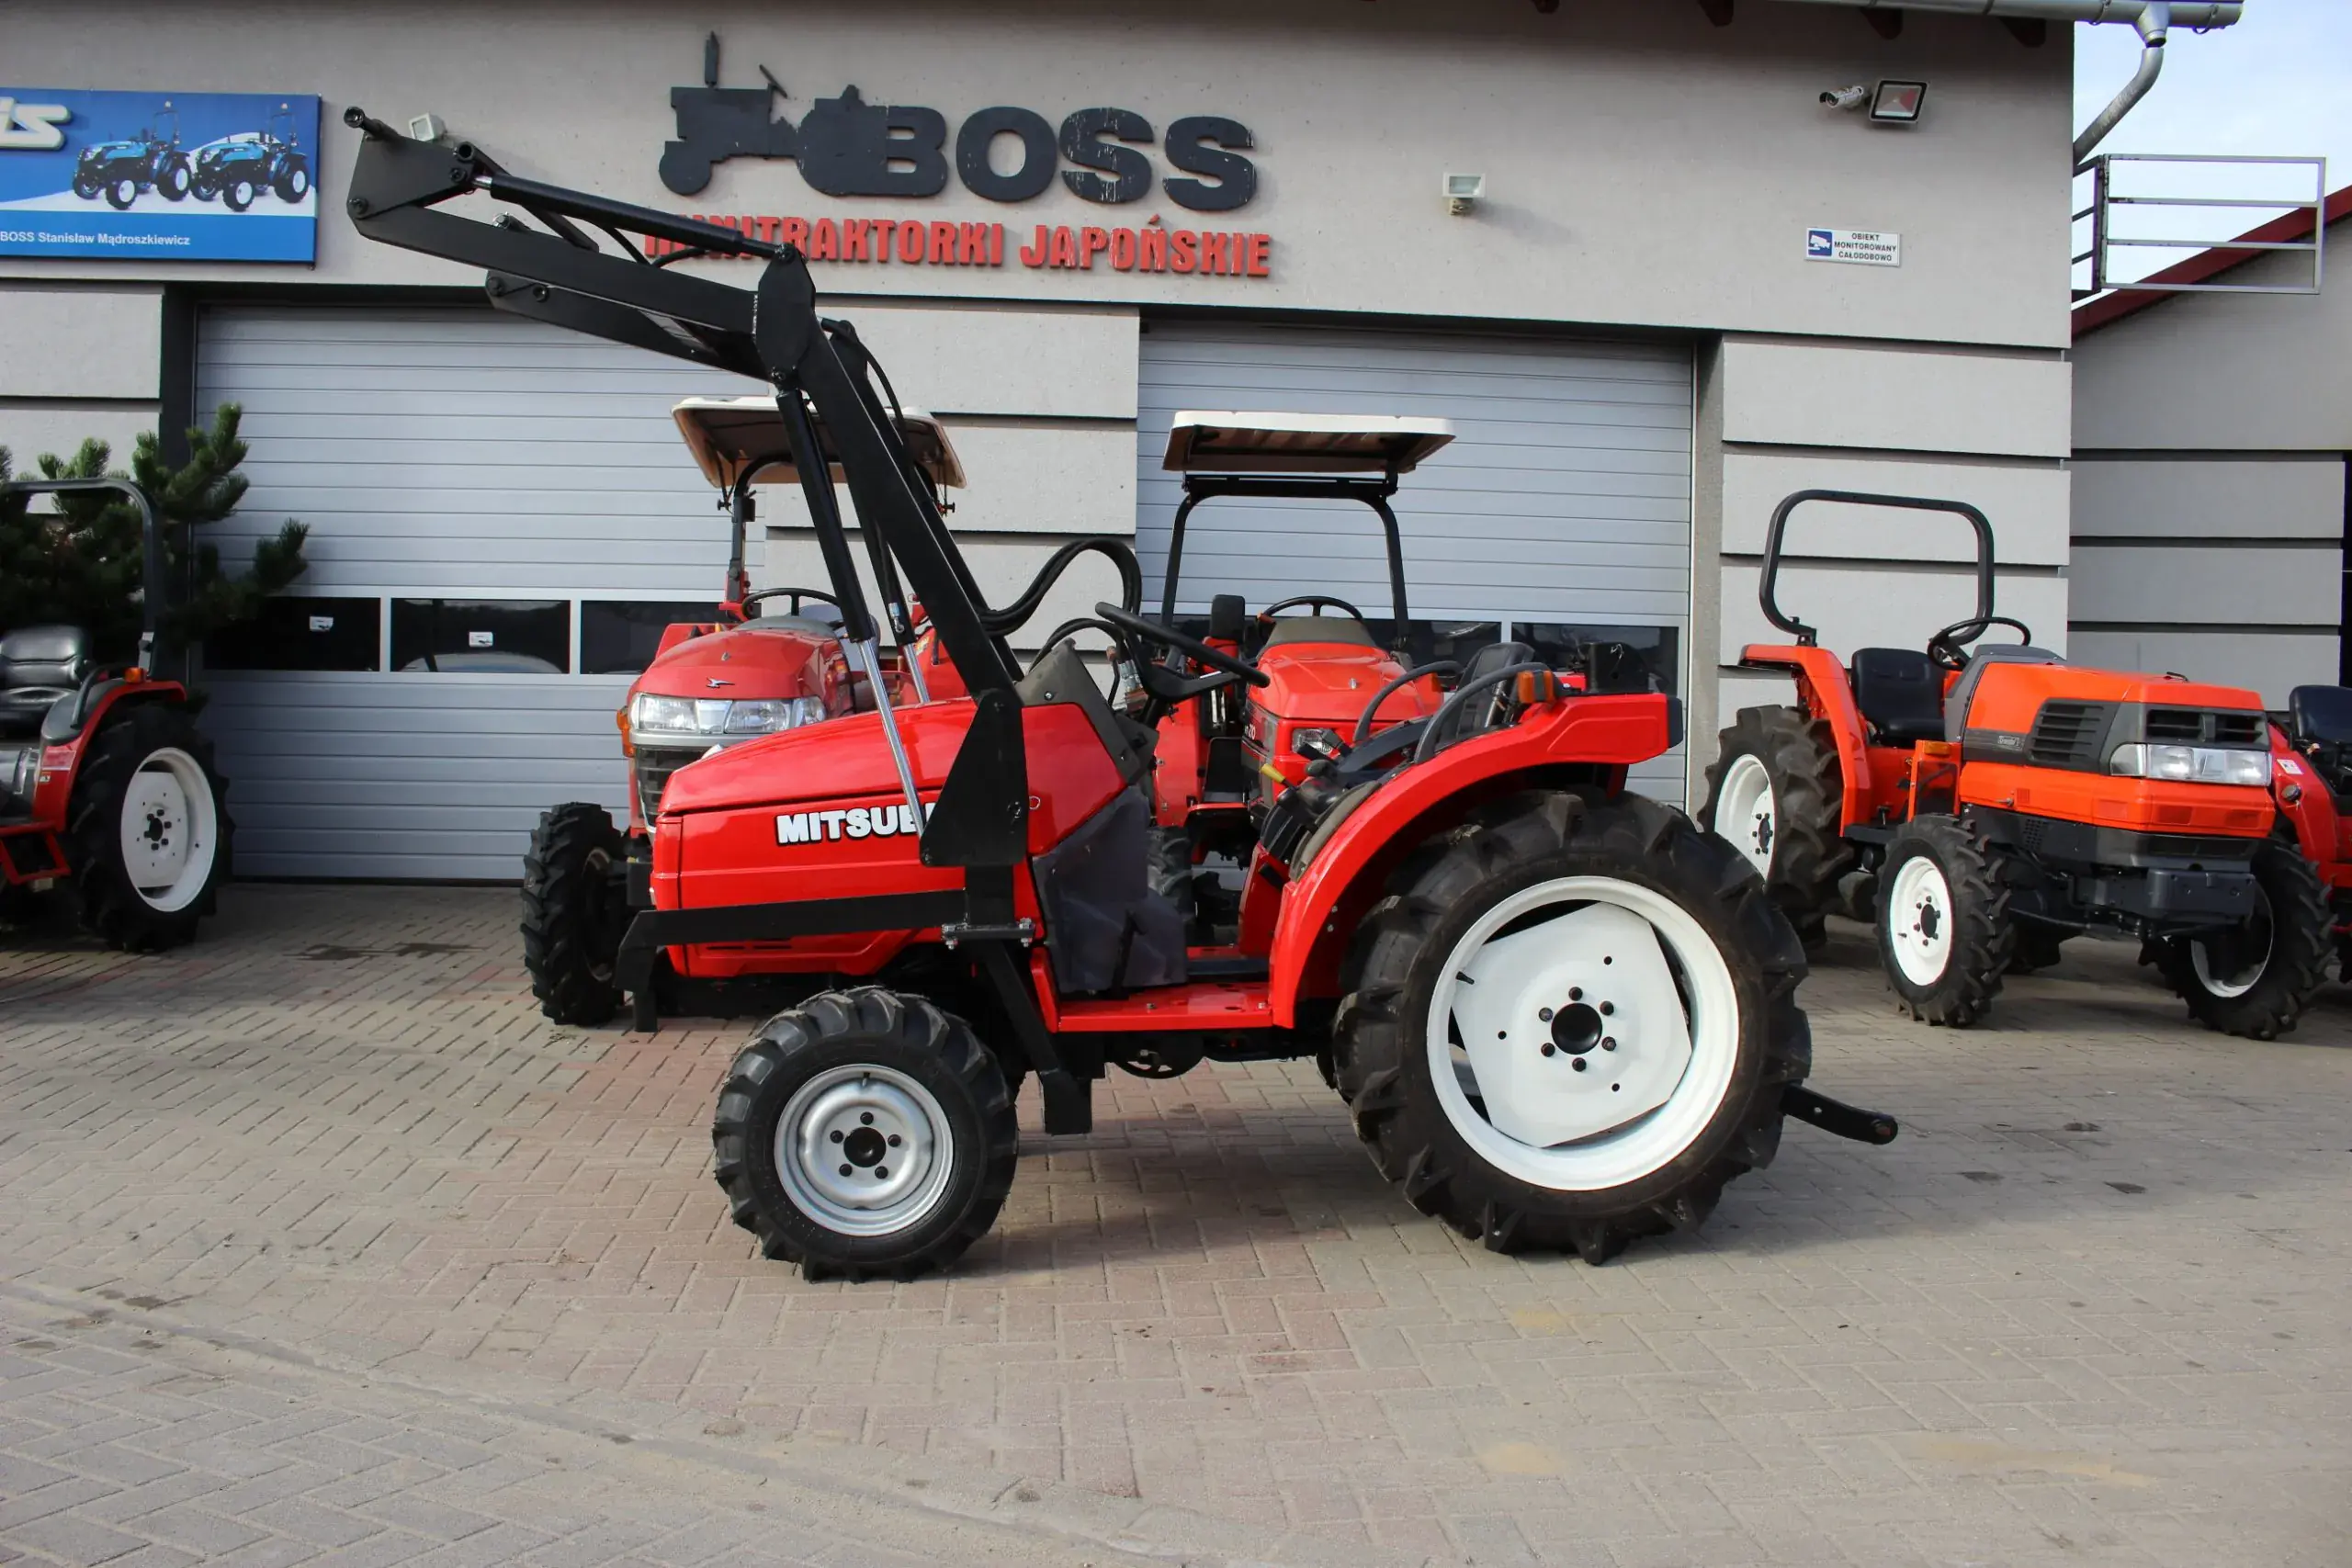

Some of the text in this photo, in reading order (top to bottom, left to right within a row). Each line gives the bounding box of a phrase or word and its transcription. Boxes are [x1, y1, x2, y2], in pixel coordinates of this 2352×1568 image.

[850, 105, 1258, 211] BOSS
[0, 231, 190, 246] BOSS Stanisław Mądroszkiewicz
[1851, 232, 1880, 241] OBIEKT
[1019, 214, 1272, 276] JAPOŃSKIE
[1834, 241, 1896, 253] MONITOROWANY
[1838, 251, 1893, 261] CAŁODOBOWO
